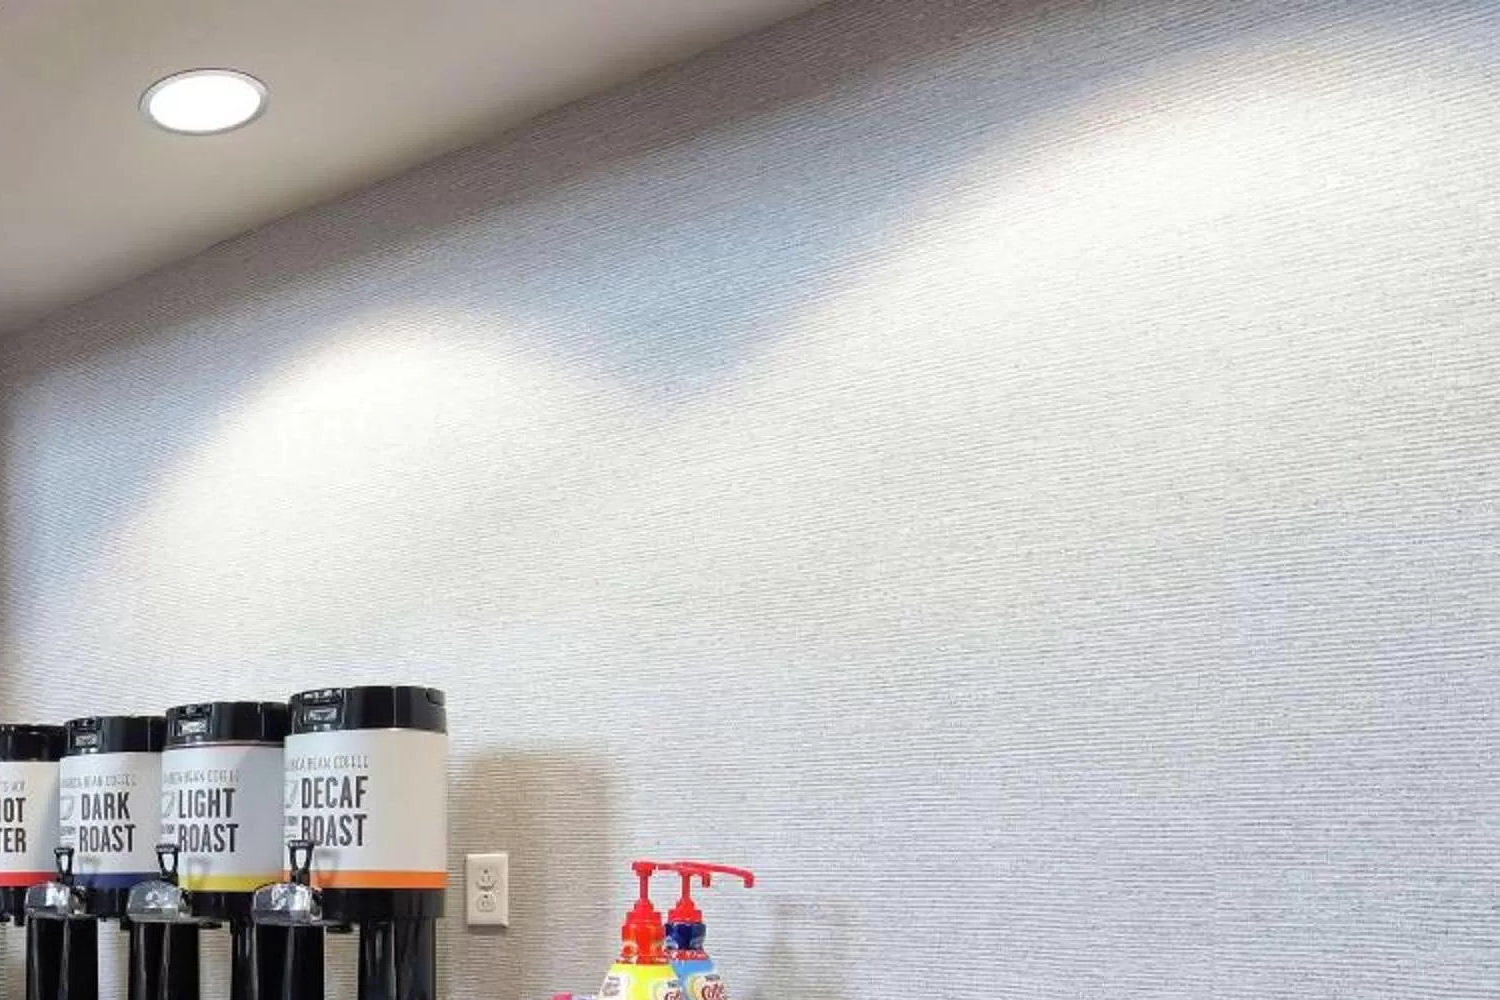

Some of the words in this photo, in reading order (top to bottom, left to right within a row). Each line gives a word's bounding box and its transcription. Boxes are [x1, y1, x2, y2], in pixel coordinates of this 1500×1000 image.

[81, 792, 131, 821] DARK
[178, 787, 236, 819] LIGHT
[301, 776, 369, 809] DECAF
[79, 824, 136, 853] ROAST
[178, 823, 239, 853] ROAST
[300, 814, 367, 847] ROAST
